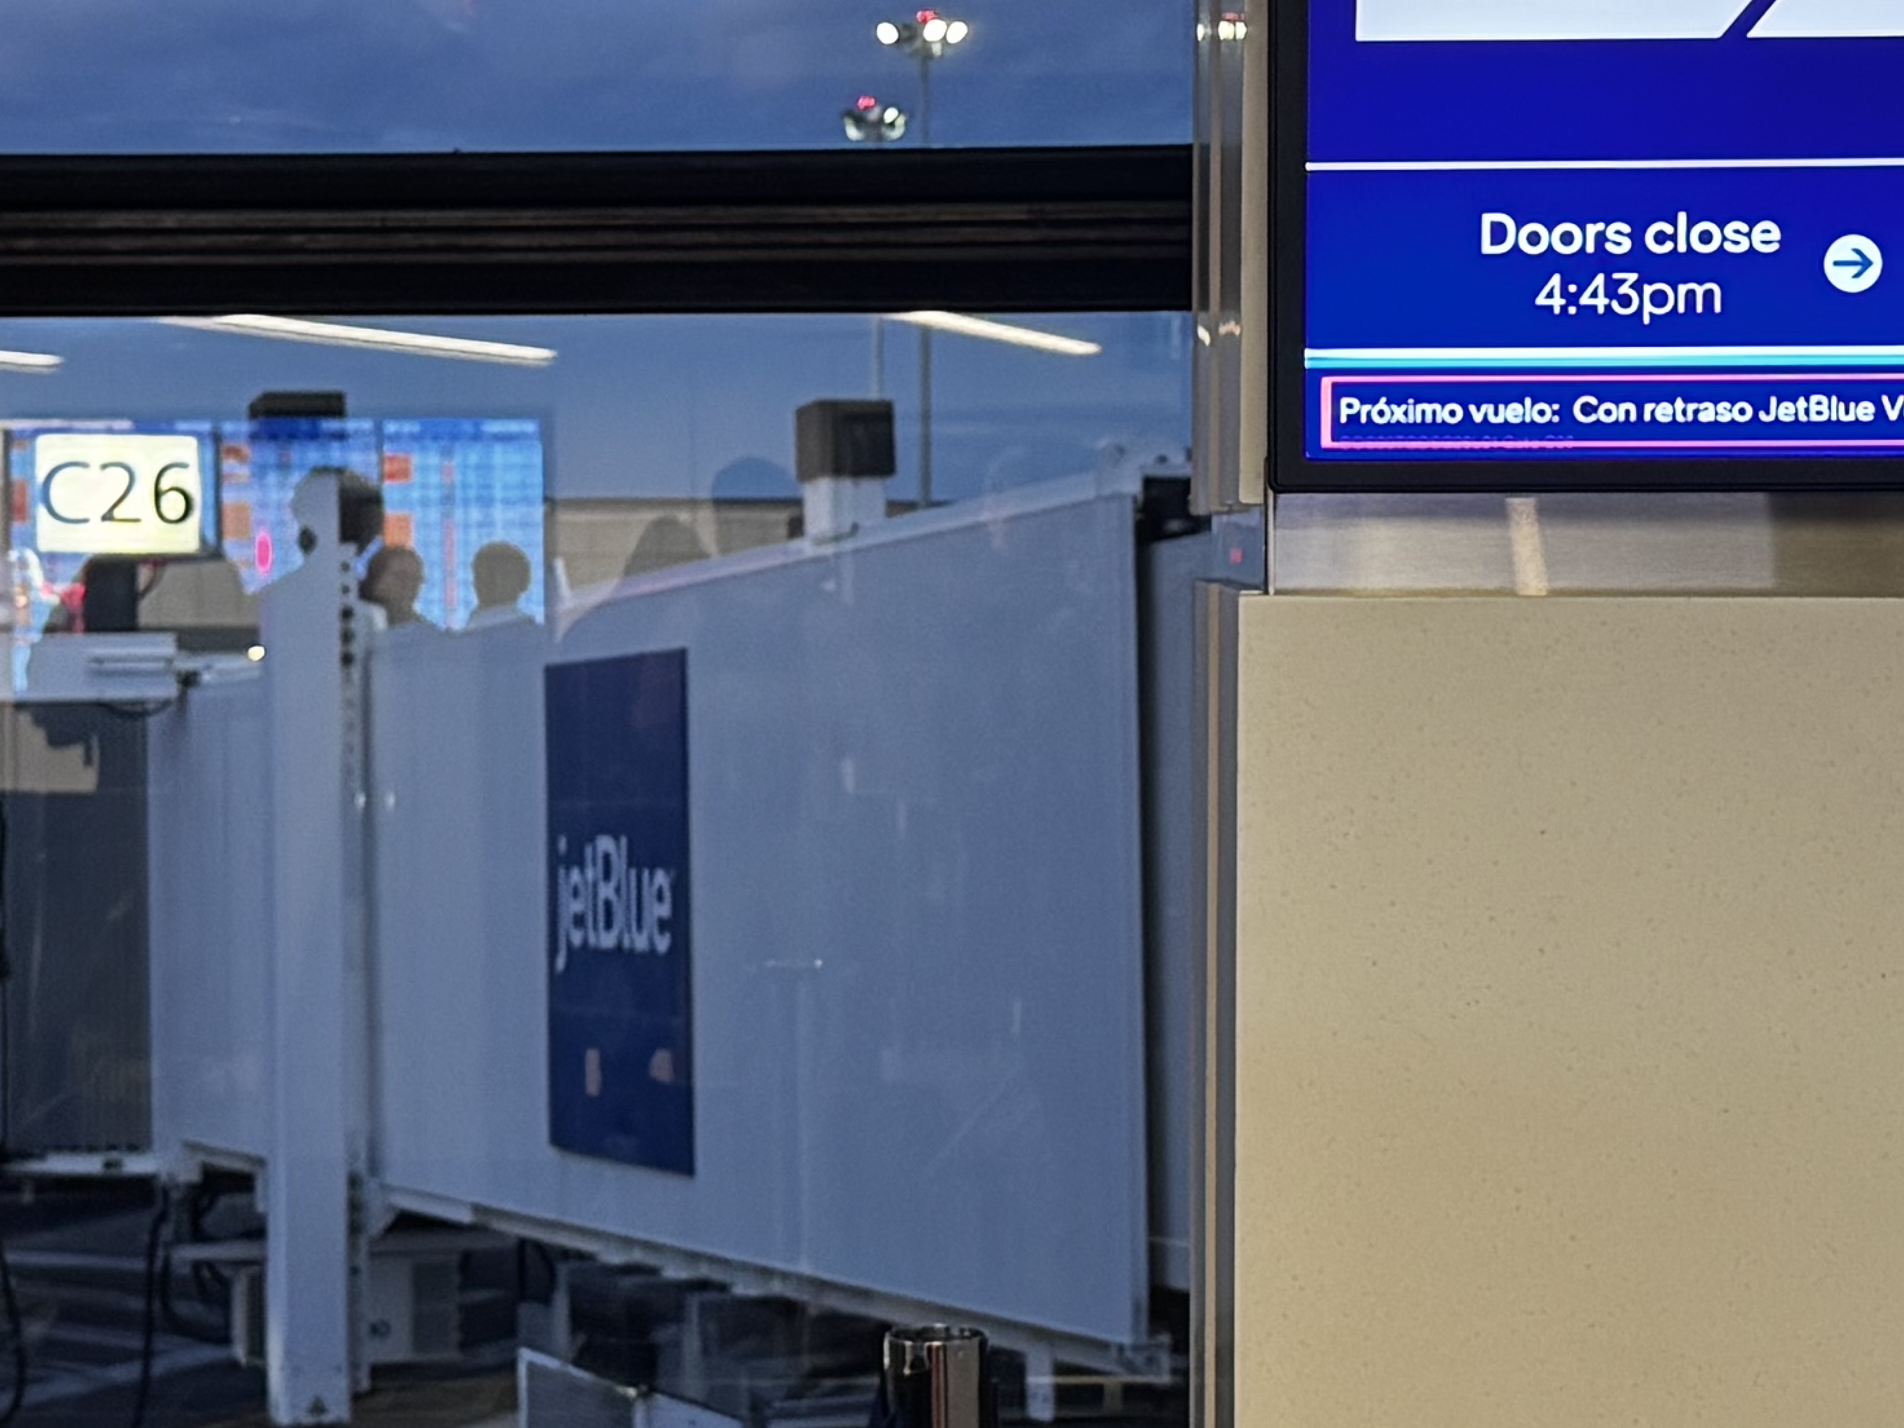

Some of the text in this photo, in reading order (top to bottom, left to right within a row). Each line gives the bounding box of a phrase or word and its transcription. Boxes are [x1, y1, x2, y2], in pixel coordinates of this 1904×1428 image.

[1482, 212, 1781, 254] Doors close
[1535, 273, 1721, 324] 4:43pm
[1340, 397, 1463, 424] Próximo
[1469, 397, 1559, 423] vuelo:
[1573, 396, 1636, 423] Con
[1644, 397, 1753, 422] retraso
[1759, 395, 1875, 422] JetBlue
[39, 461, 195, 526] C26
[556, 835, 671, 972] jetBlue
